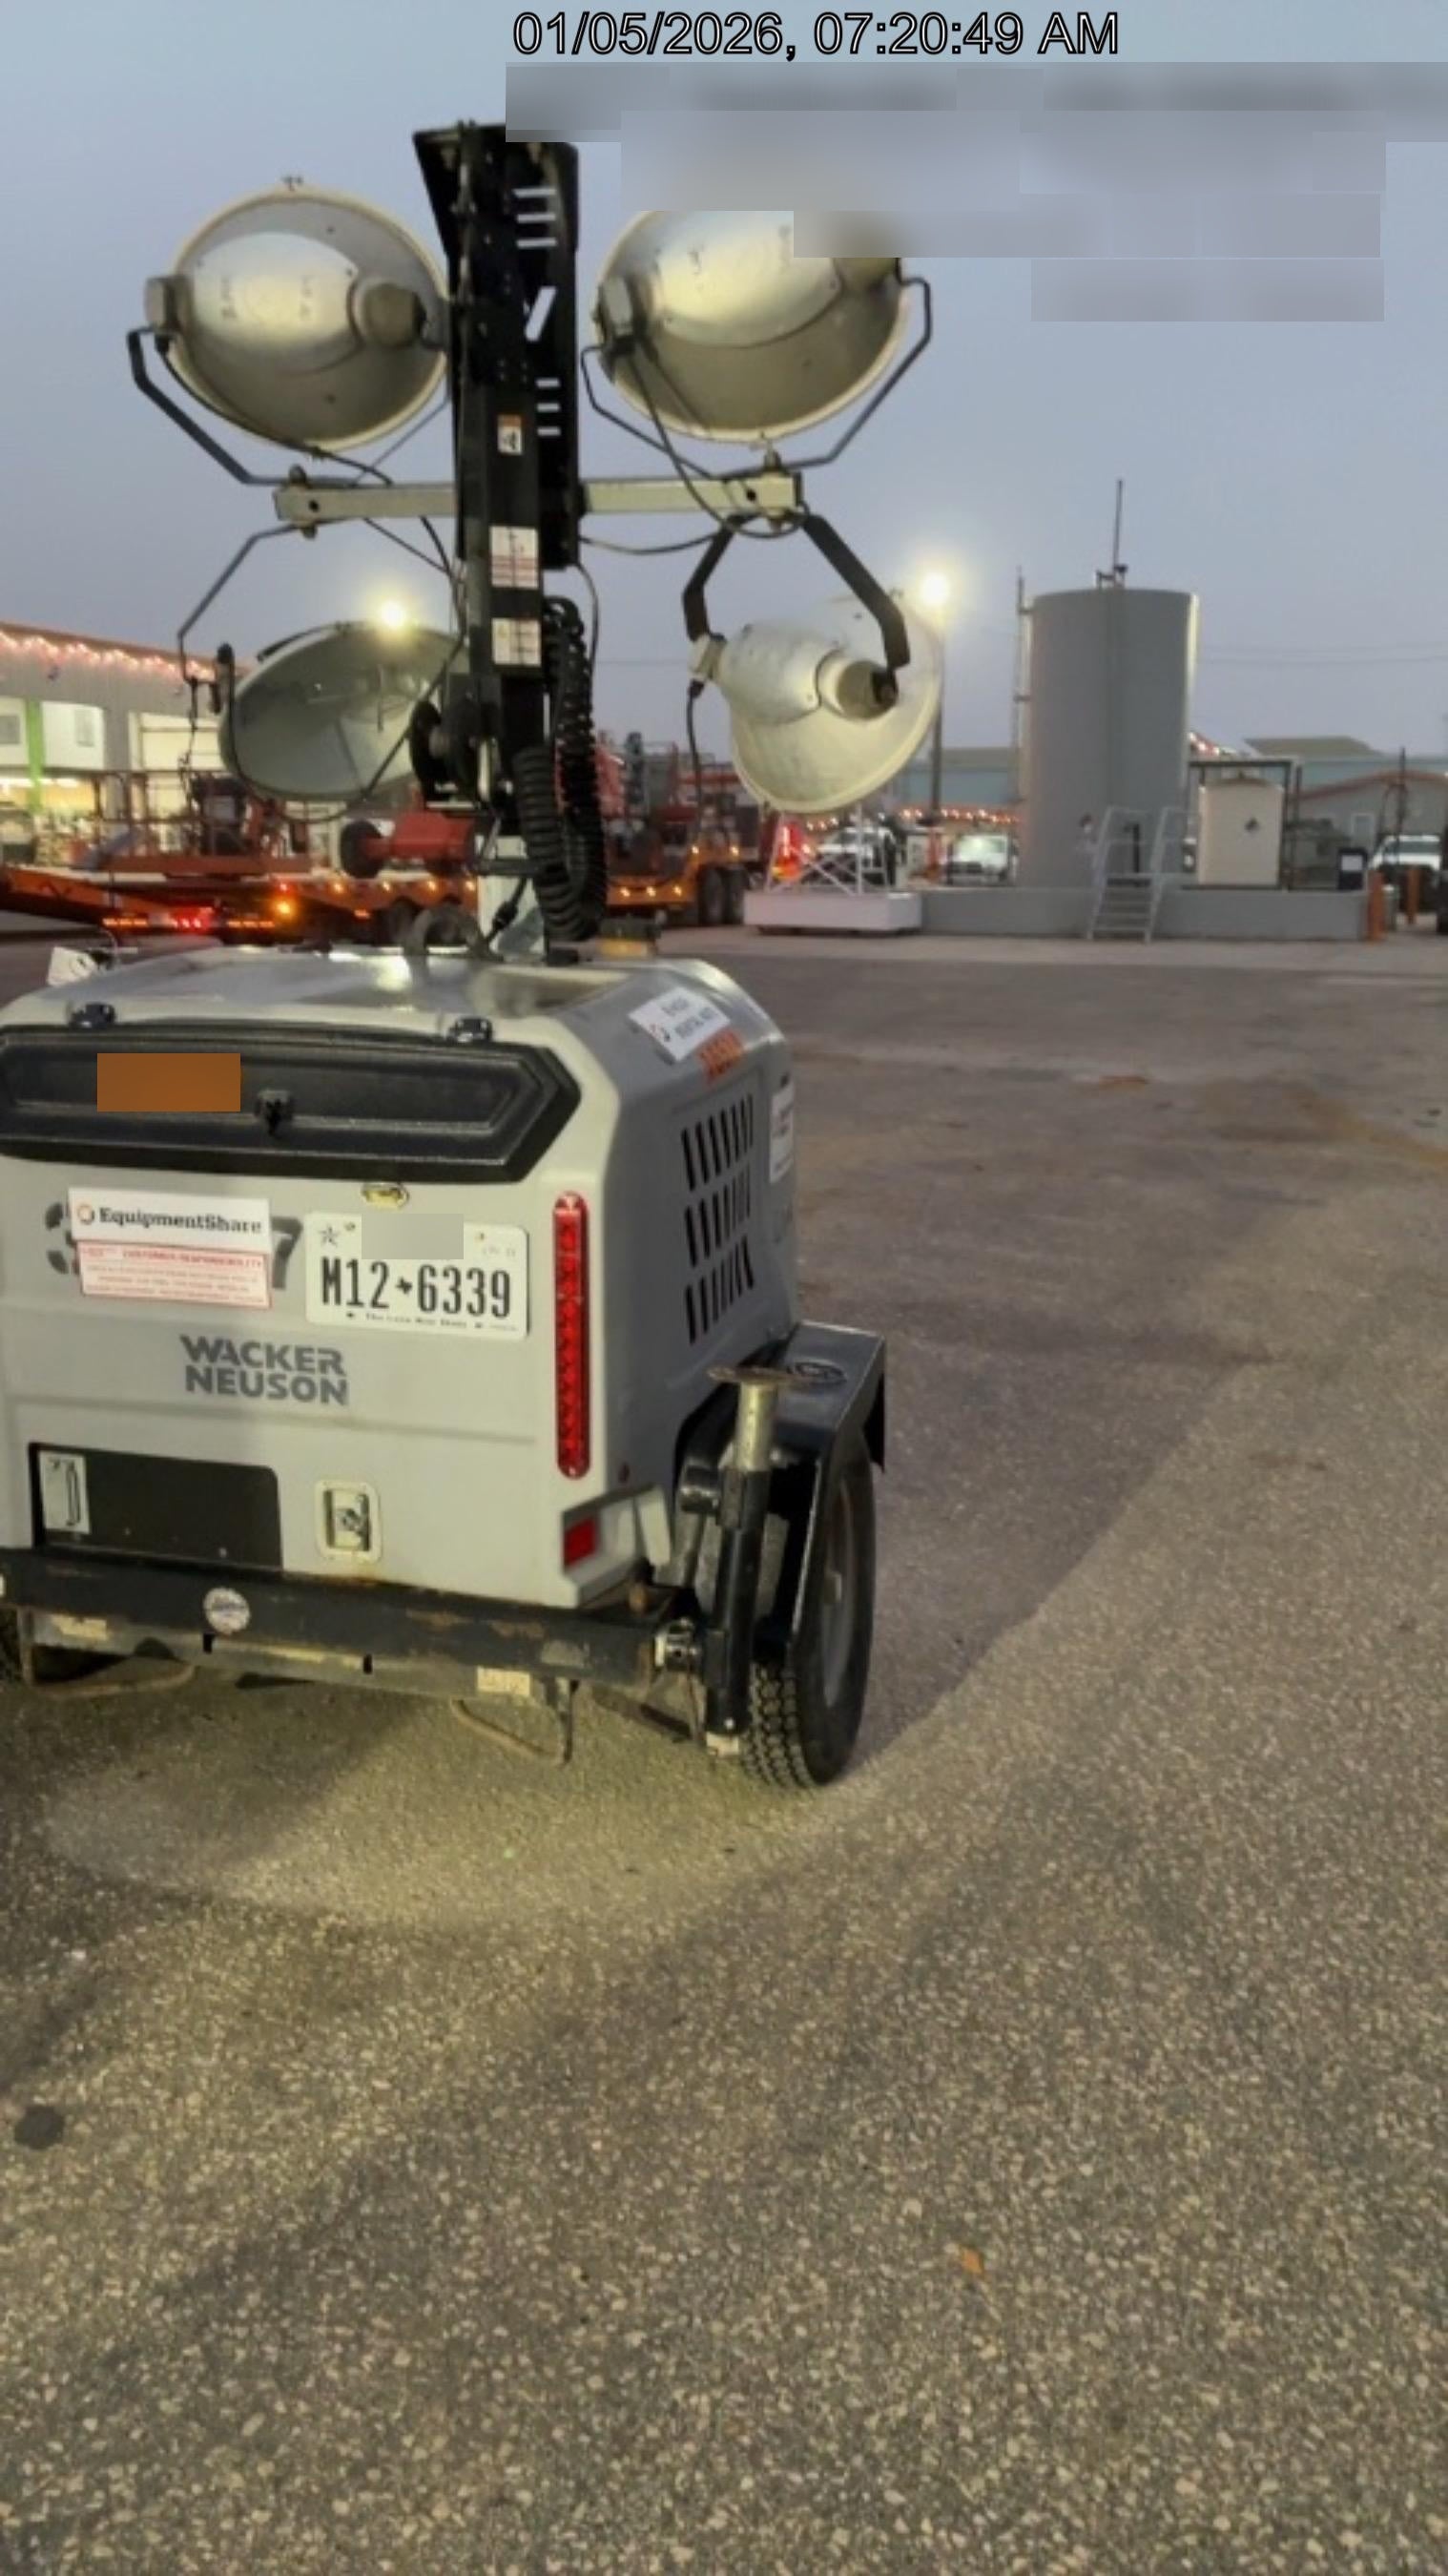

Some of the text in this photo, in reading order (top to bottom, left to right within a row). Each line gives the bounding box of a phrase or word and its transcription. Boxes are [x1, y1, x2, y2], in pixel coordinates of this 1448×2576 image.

[99, 1207, 262, 1234] EquipmentShare
[179, 1334, 346, 1377] WACKER
[185, 1364, 349, 1405] NEUSON
